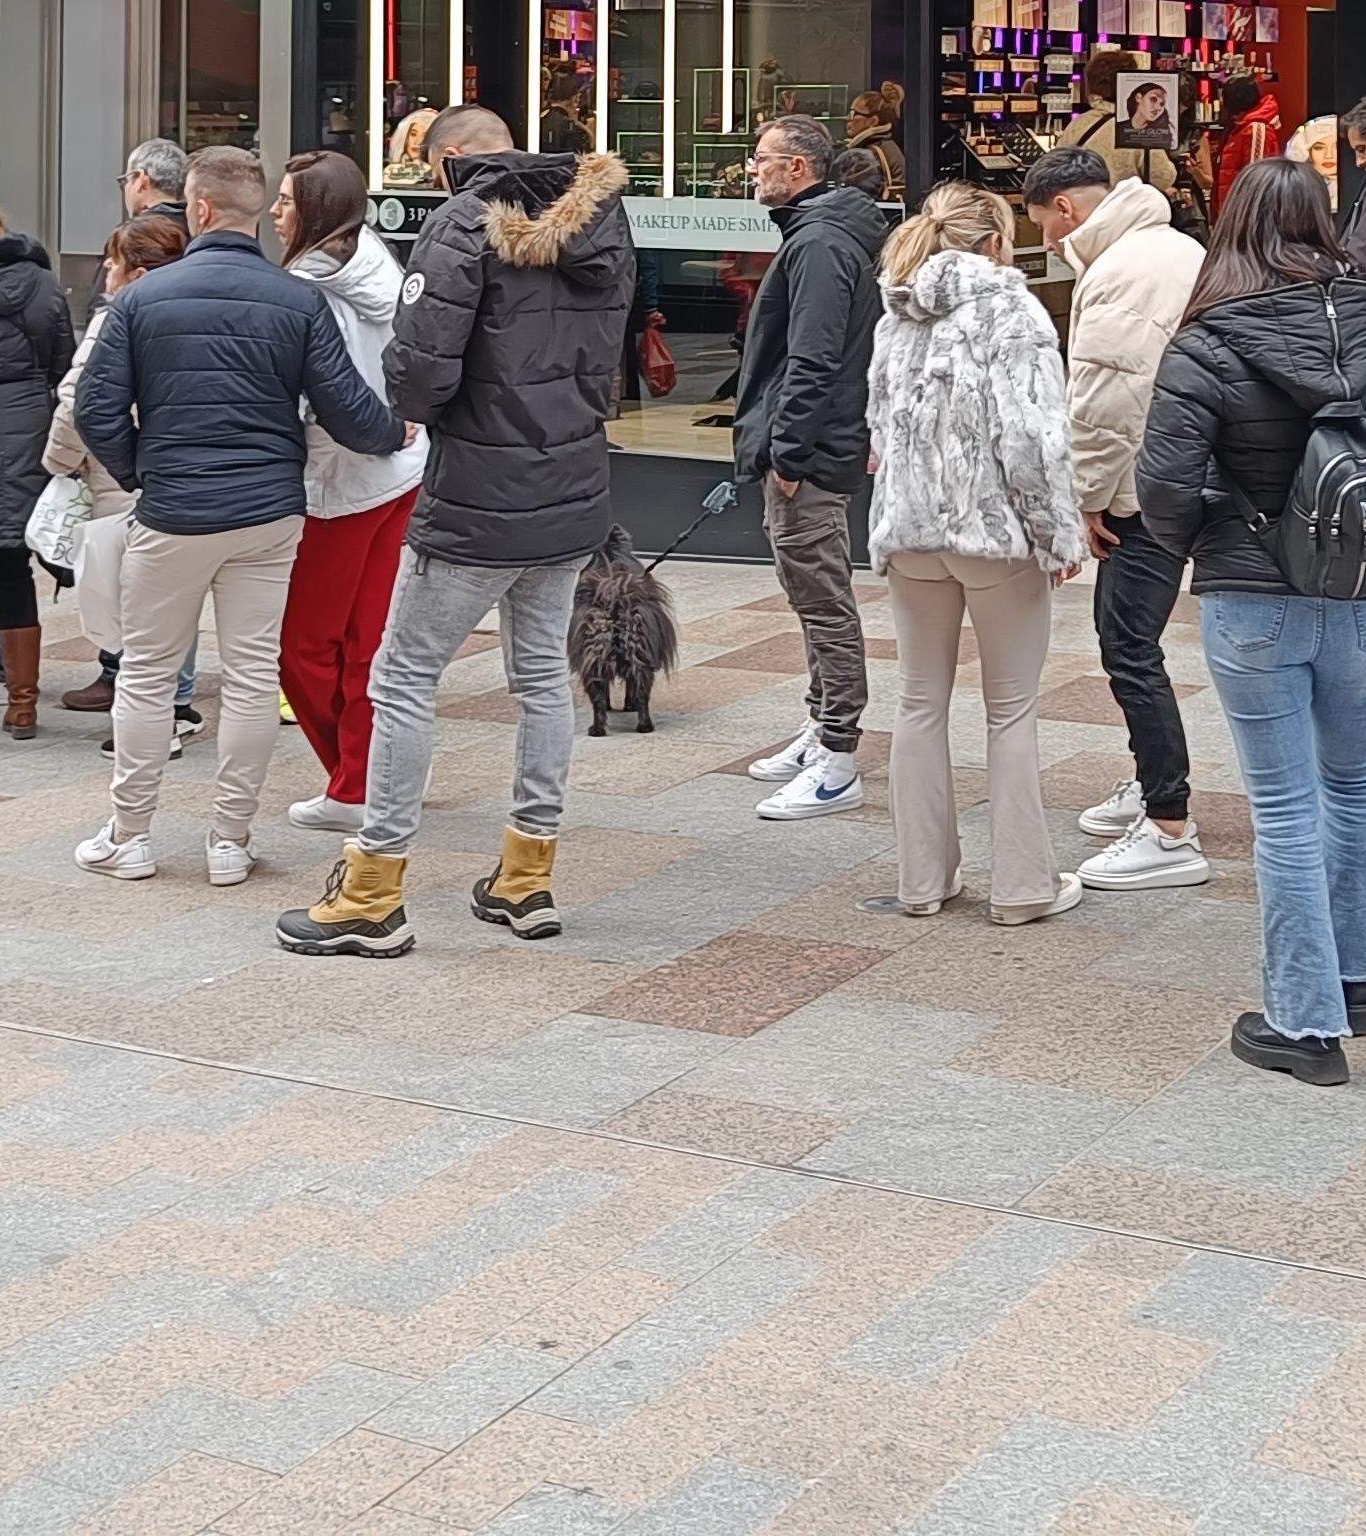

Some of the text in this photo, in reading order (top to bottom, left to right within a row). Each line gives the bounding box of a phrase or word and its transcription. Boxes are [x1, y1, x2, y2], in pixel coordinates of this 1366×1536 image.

[629, 214, 781, 233] MAKEUP MADE SIMP
